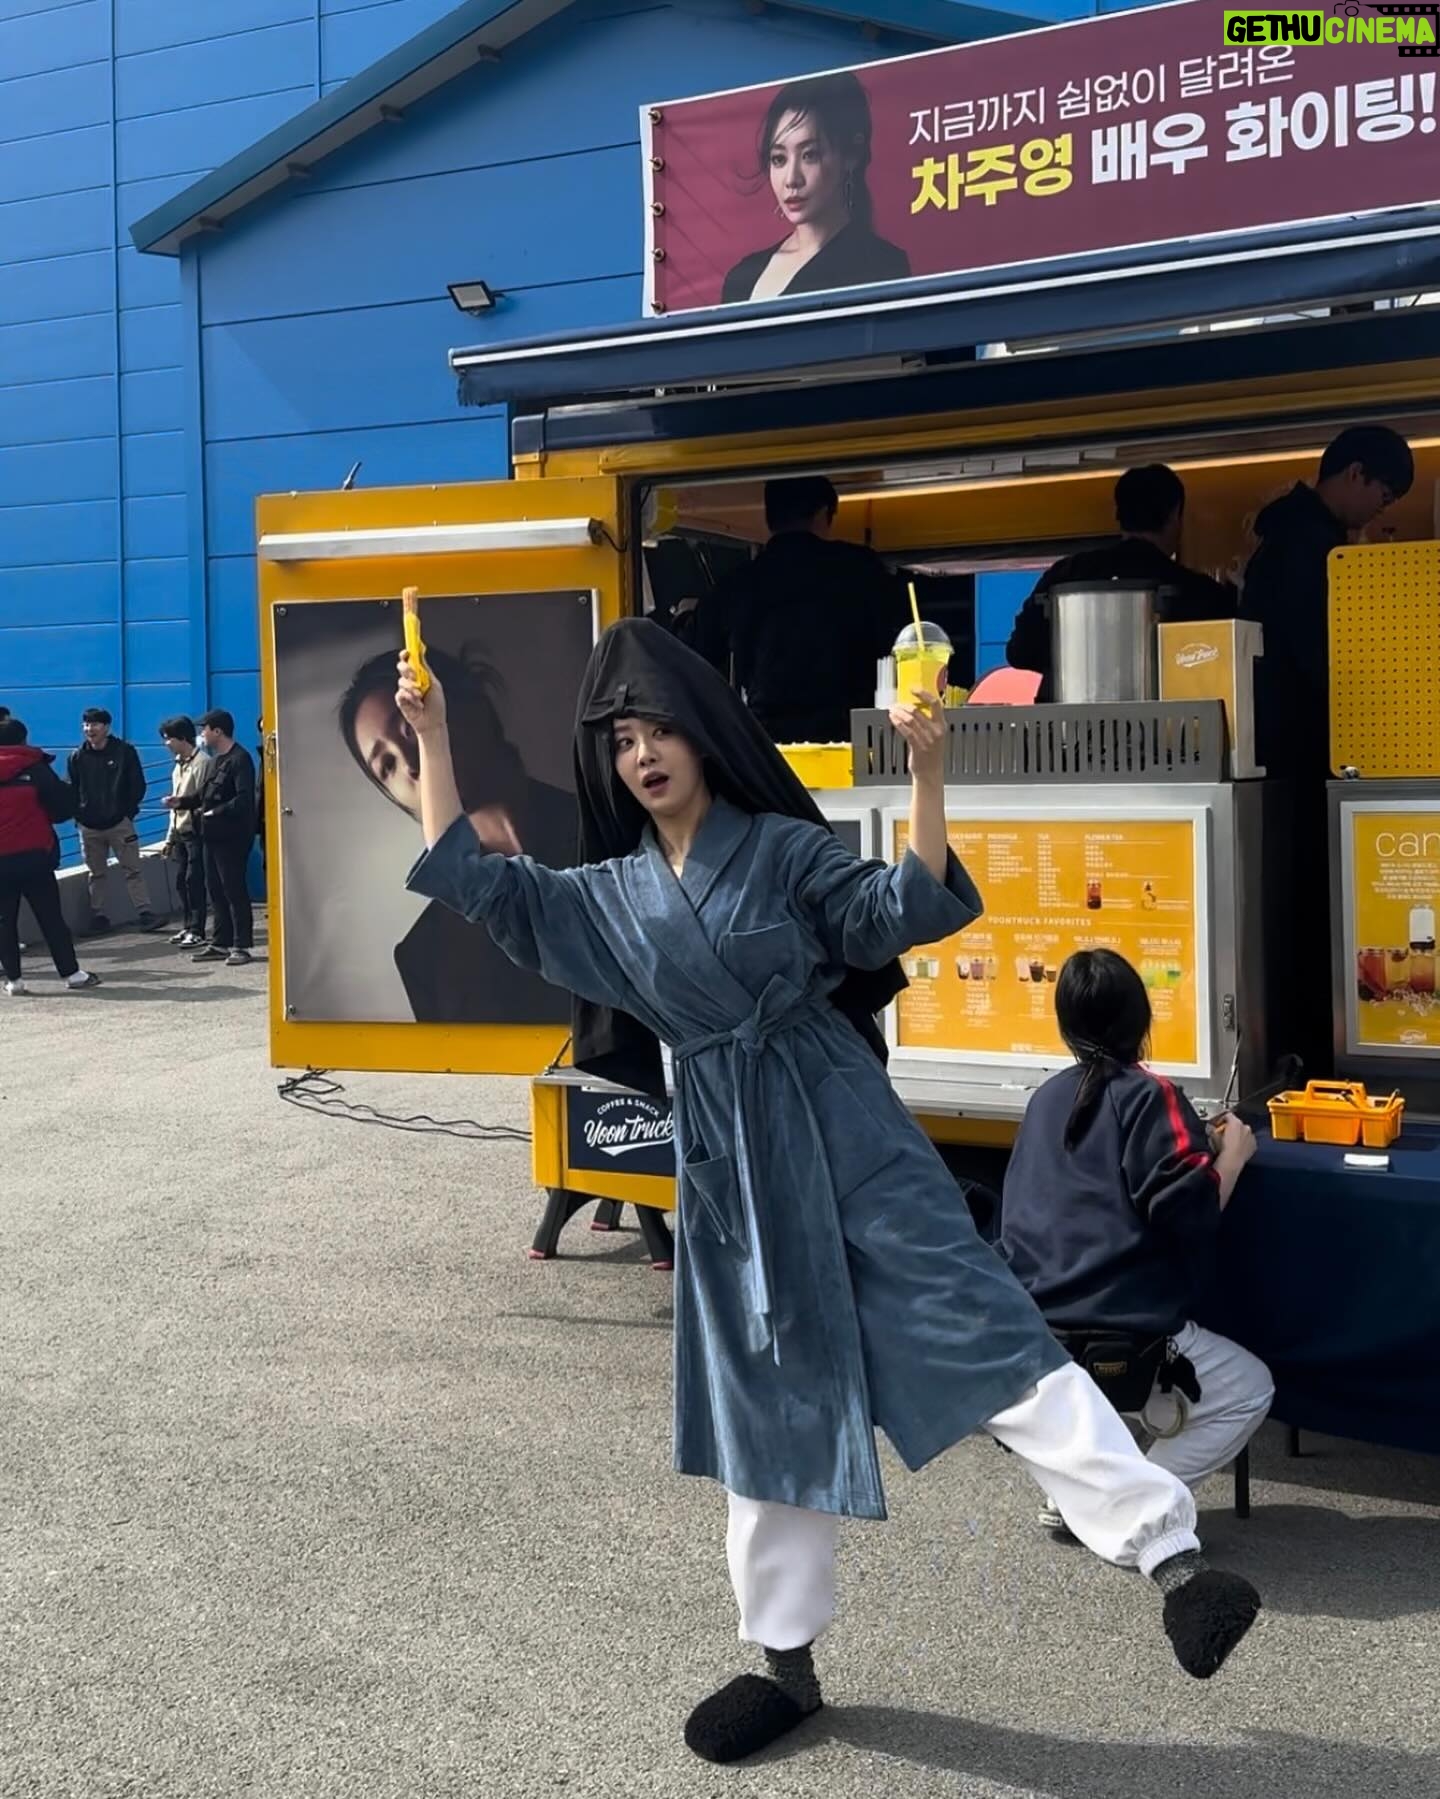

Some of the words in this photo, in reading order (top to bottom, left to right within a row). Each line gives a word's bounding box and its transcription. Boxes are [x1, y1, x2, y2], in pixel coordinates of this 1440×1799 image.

[908, 86, 1046, 145] 지금까지
[1056, 63, 1166, 120] 쉼없이
[1178, 44, 1296, 99] 달려온
[910, 132, 1074, 215] 차주영
[1091, 112, 1209, 185] 배우
[1225, 71, 1437, 163] 화이팅!
[1043, 917, 1092, 928] FAVORITES
[597, 1098, 625, 1116] COFFEE
[634, 1099, 660, 1119] SNACK
[583, 1119, 628, 1148] Yoon
